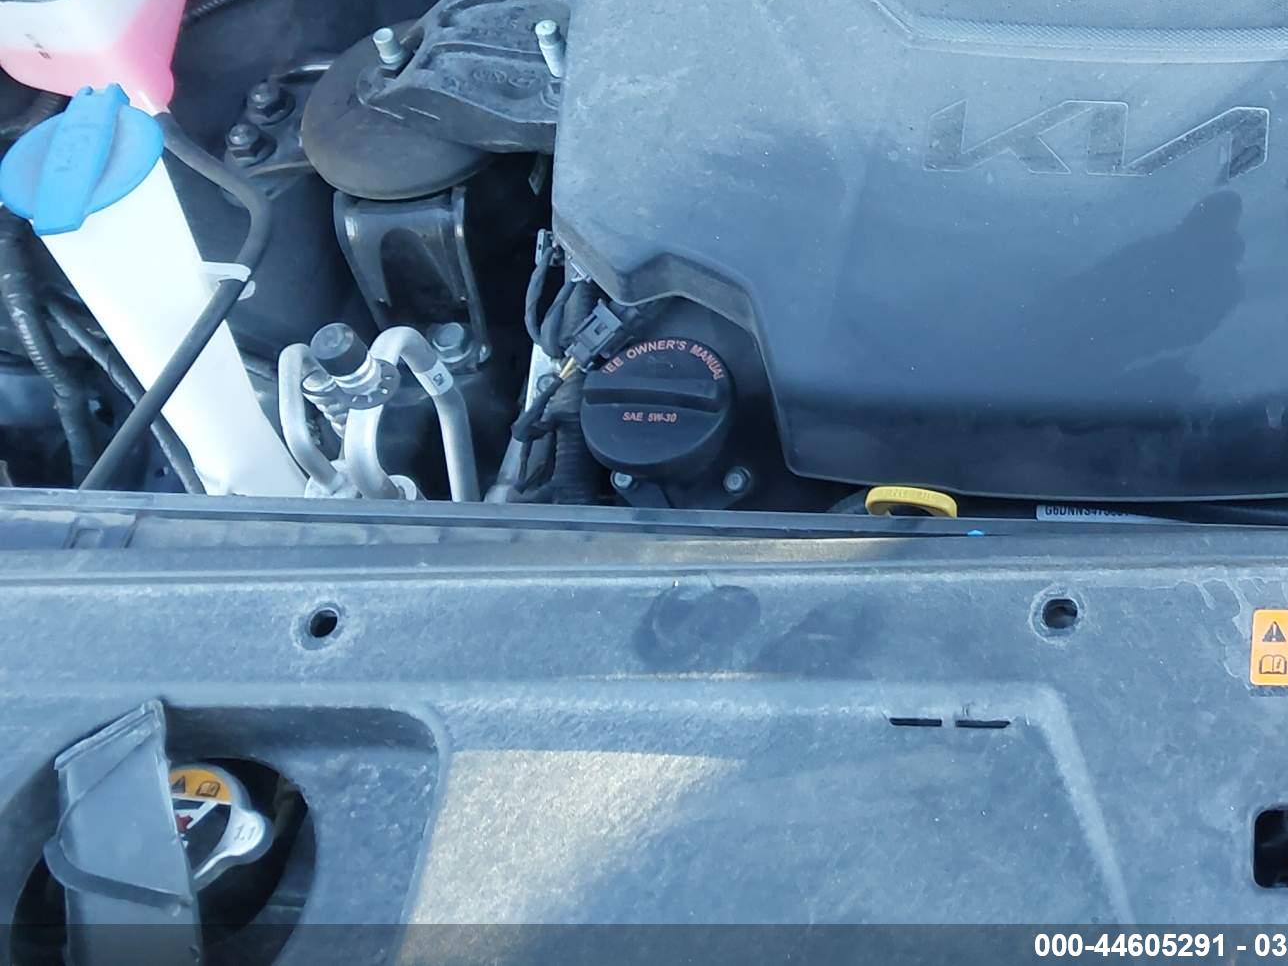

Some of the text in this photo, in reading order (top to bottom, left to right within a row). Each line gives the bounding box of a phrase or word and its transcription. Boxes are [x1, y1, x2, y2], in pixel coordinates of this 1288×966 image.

[922, 99, 1270, 180] KIA
[625, 339, 688, 360] OWNER'S
[622, 411, 678, 423] SAE 5W-30
